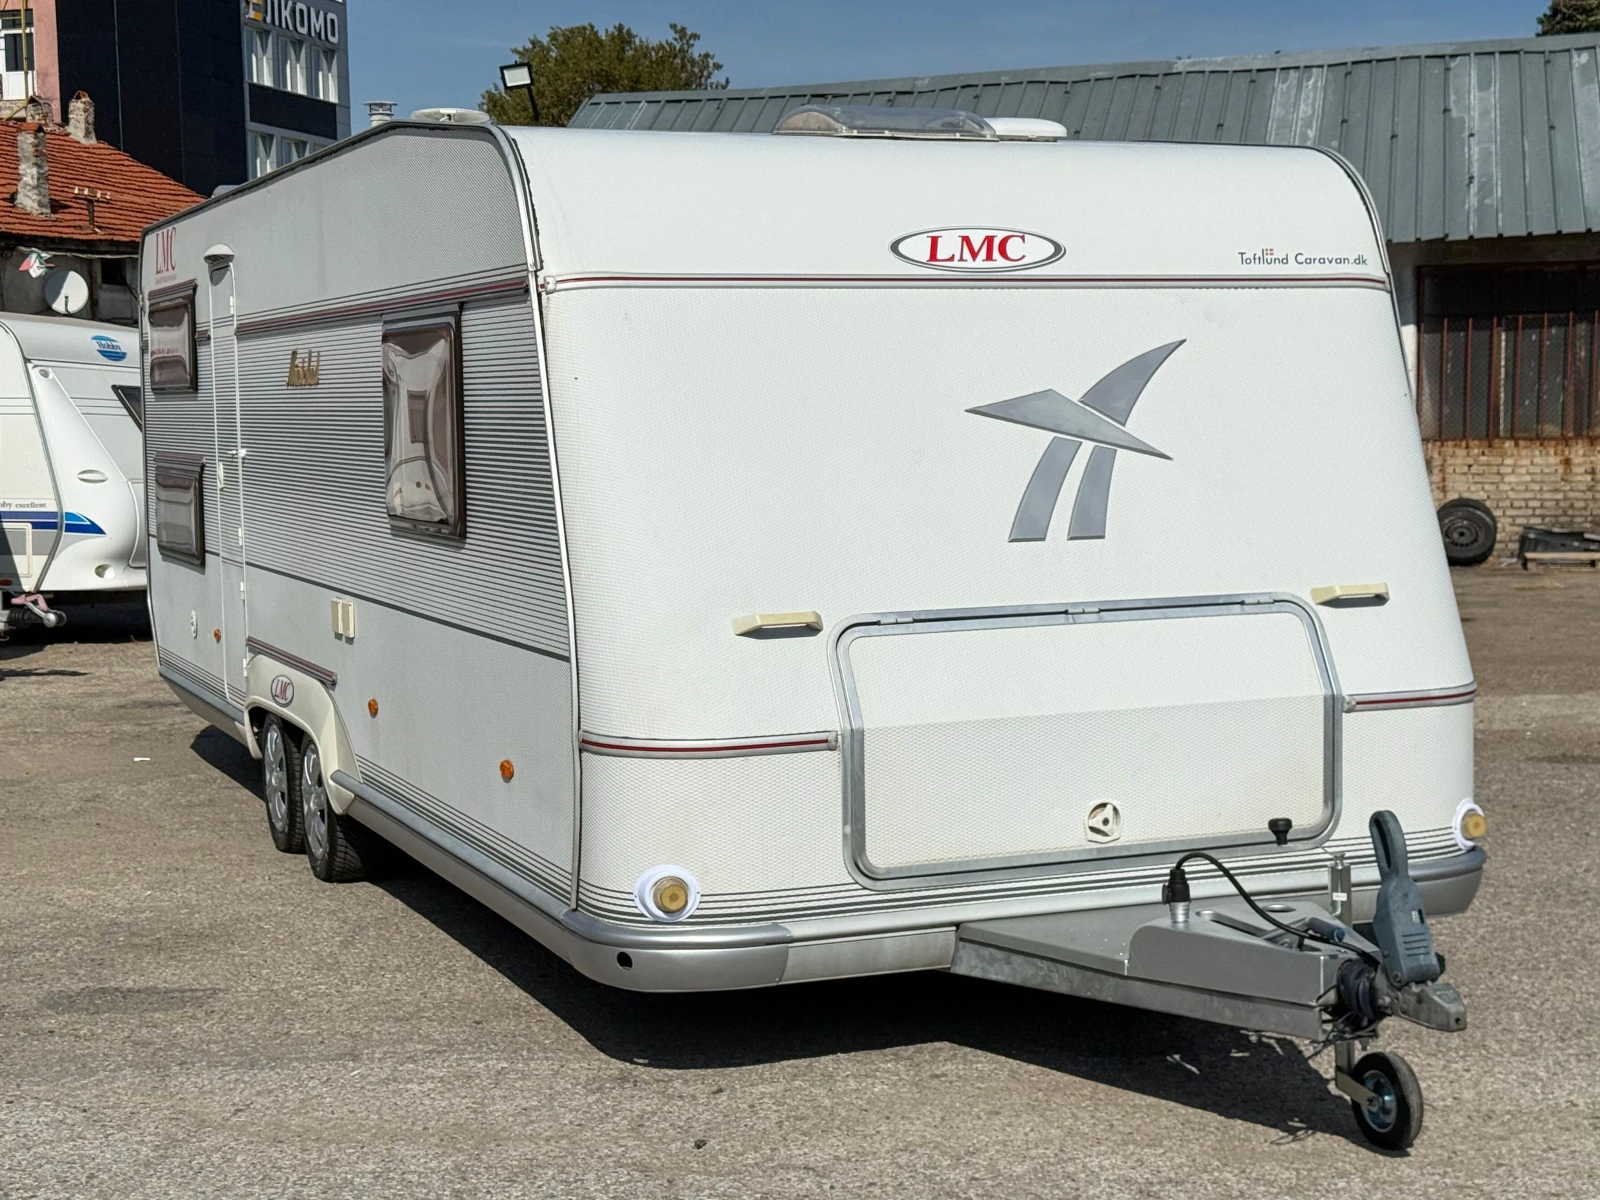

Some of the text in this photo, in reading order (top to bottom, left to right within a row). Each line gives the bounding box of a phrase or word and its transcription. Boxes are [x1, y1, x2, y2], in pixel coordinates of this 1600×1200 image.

[155, 226, 177, 275] LMC
[926, 234, 1026, 263] LMC
[1237, 248, 1368, 266] Toftlund Caravan.dk
[14, 501, 47, 509] excellent
[274, 678, 291, 702] LMC
